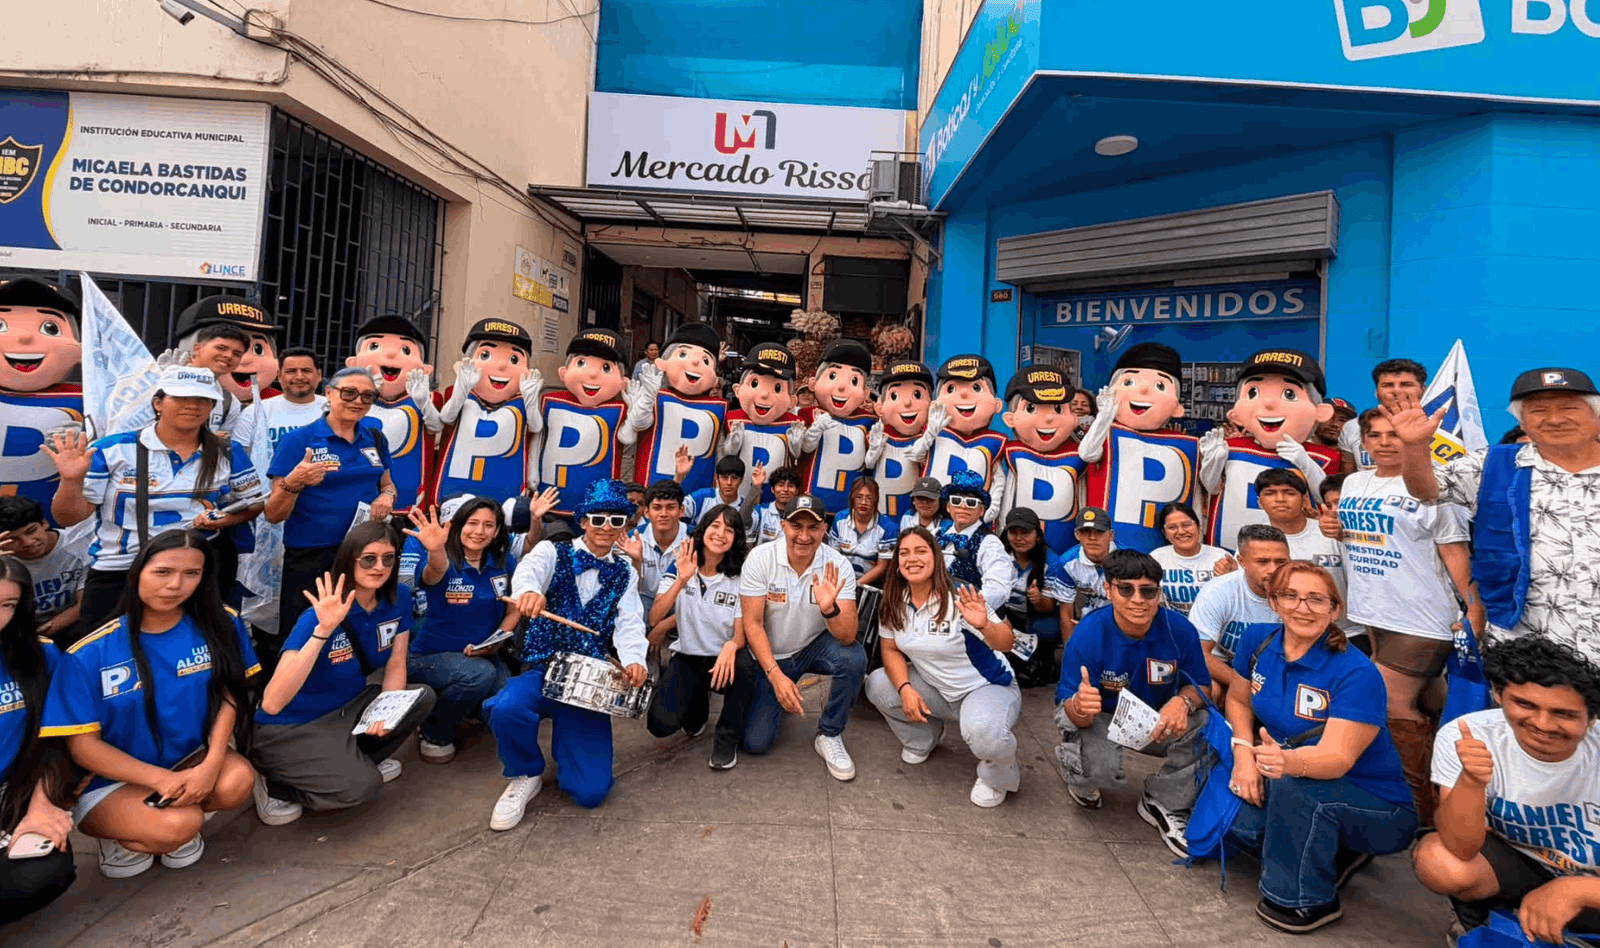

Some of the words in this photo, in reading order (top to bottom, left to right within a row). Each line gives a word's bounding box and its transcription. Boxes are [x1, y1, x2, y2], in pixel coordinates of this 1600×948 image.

[80, 125, 139, 138] INSTITUCIÓN
[140, 129, 193, 141] EDUCATIVA
[194, 131, 245, 143] MUNICIPAL
[72, 158, 154, 176] MICAELA
[157, 163, 248, 182] BASTIDAS
[610, 150, 775, 185] Mercado
[69, 176, 95, 192] DE
[98, 178, 247, 201] CONDORCANQUI
[87, 217, 118, 227] INICIAL
[124, 219, 164, 230] PRIMARIA
[170, 221, 222, 233] SECUNDARIA
[216, 302, 264, 323] URRESTI
[1055, 287, 1305, 324] BIENVENIDOS
[485, 322, 520, 336] URRESTI
[758, 350, 788, 364] URRESTI
[947, 359, 979, 369] URRESTI
[1254, 352, 1303, 367] URRESTI
[891, 366, 921, 375] URRESTI
[1028, 371, 1063, 384] URRESTI
[312, 447, 328, 456] LUIS
[446, 584, 475, 592] ALONZO
